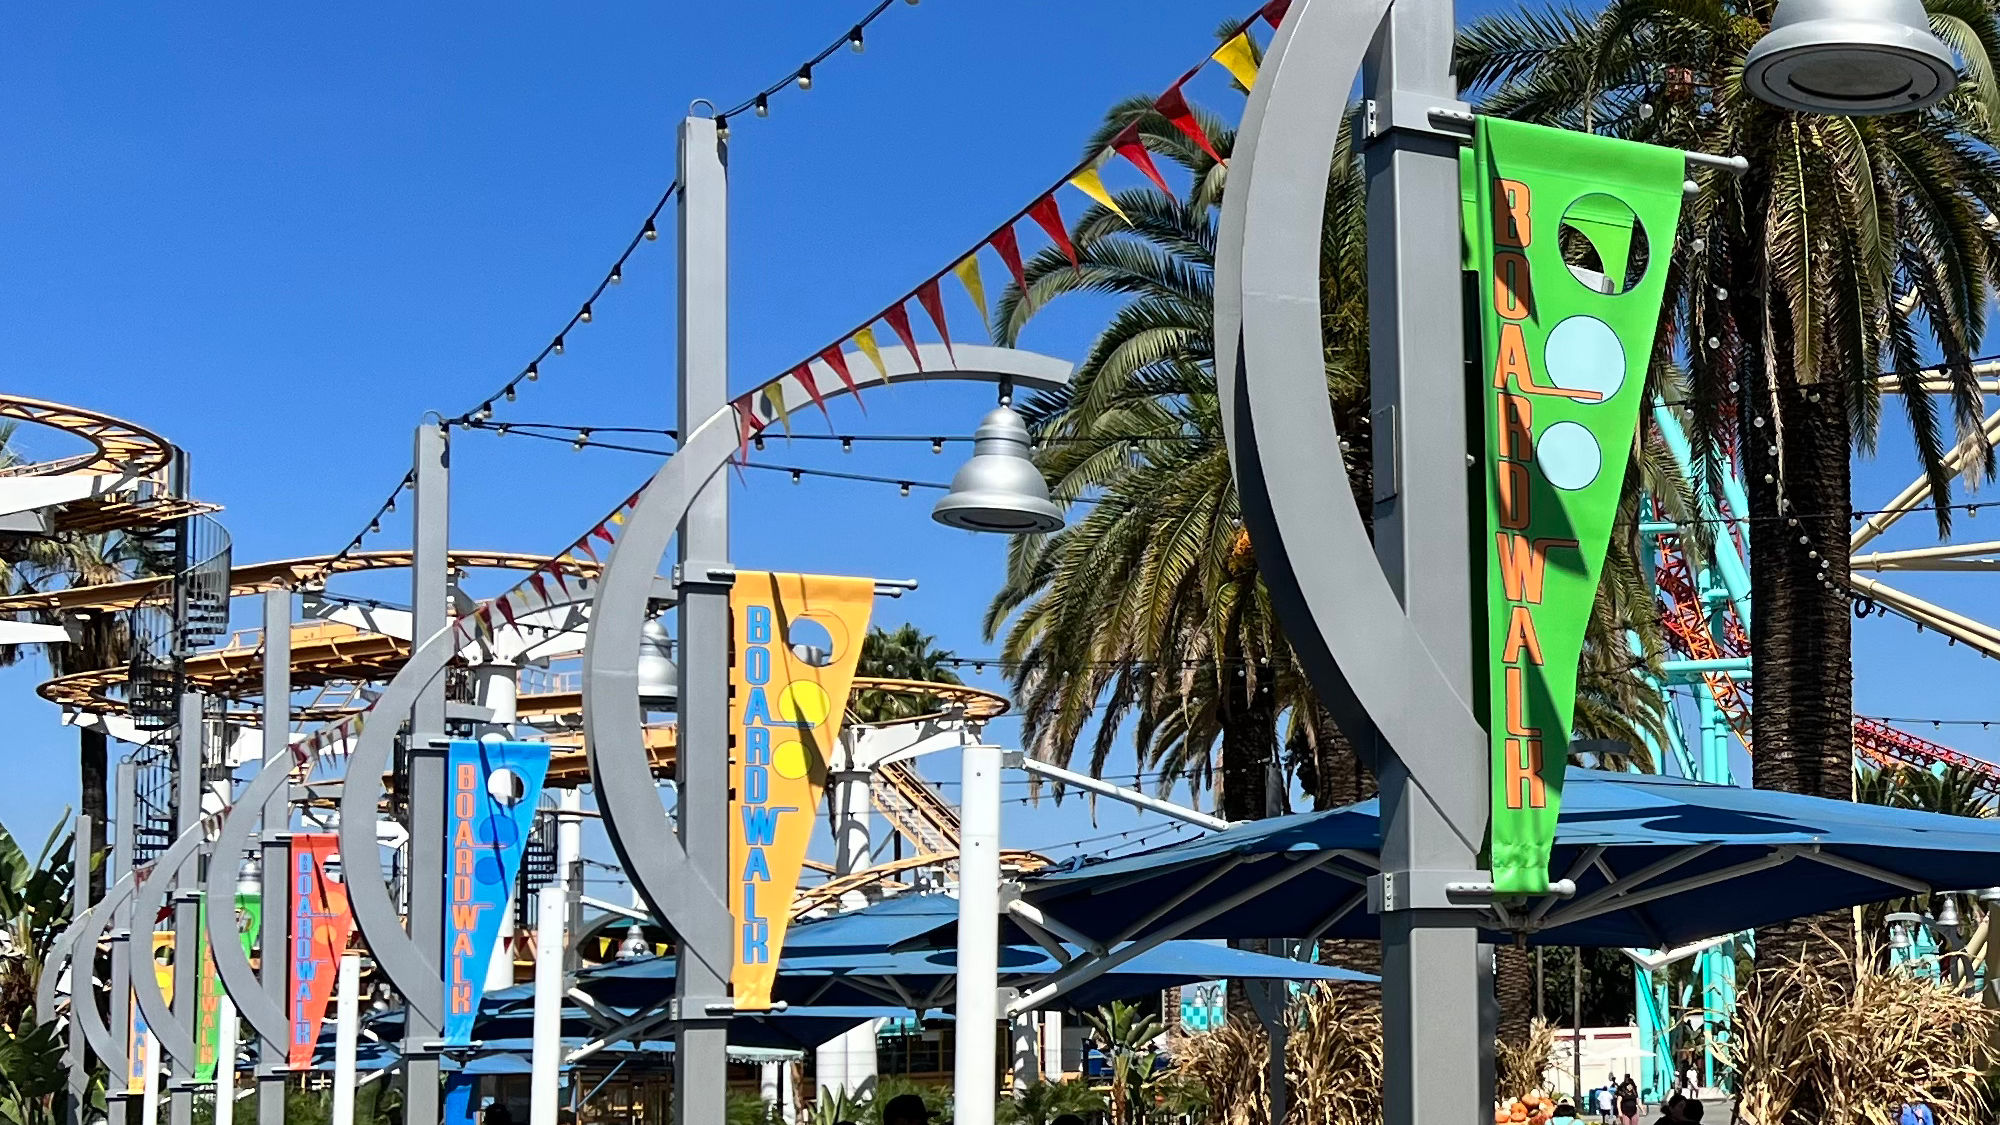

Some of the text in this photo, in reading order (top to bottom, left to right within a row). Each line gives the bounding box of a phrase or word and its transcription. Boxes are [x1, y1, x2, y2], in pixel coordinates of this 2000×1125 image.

[1493, 177, 1603, 810] BOARDWALK
[451, 763, 507, 1015] BOARDWALK
[741, 605, 815, 964] BOARDWALK
[295, 852, 339, 1045] BOARDWALK
